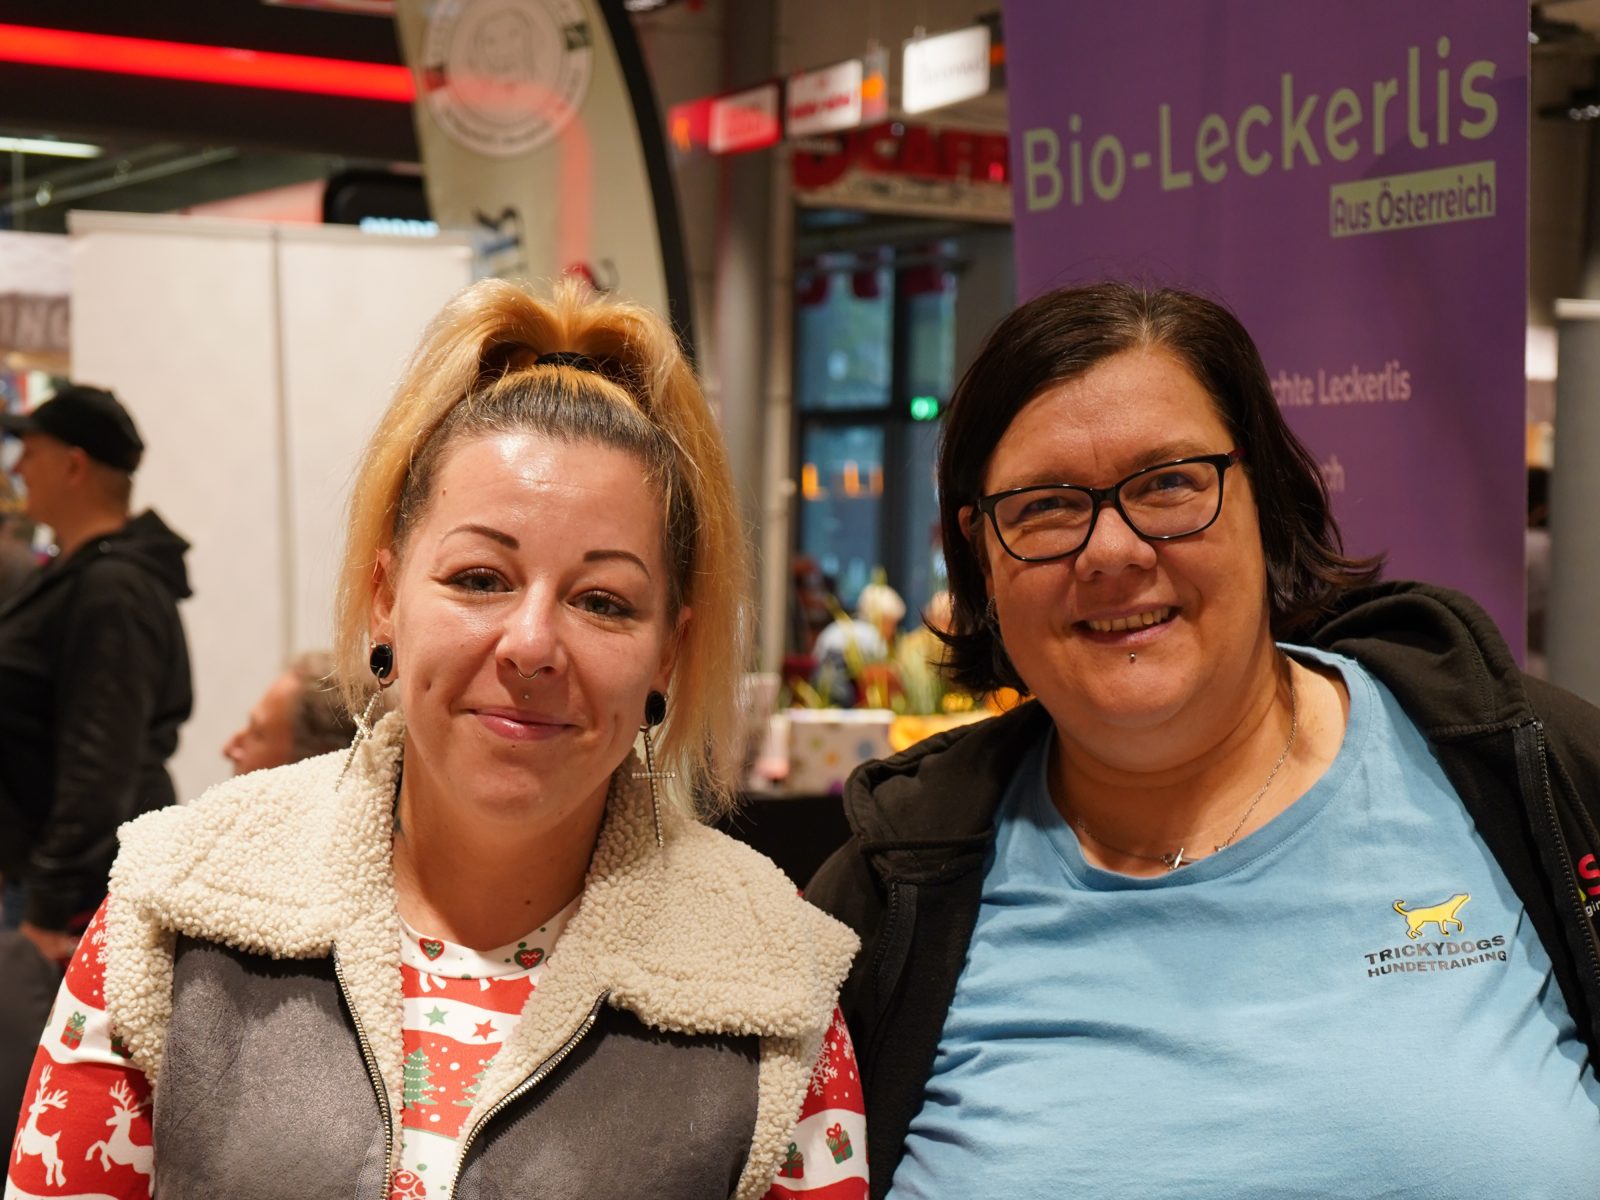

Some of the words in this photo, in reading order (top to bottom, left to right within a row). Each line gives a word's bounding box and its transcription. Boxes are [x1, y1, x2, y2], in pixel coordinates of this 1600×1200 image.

[1023, 36, 1499, 213] Bio-Leckerlis
[1334, 196, 1371, 233] Aus
[1377, 173, 1493, 227] Österreich
[1318, 360, 1412, 405] Leckerlis
[1364, 934, 1506, 965] TRICKYDOGS
[1367, 950, 1507, 978] HUNDETRAINING
